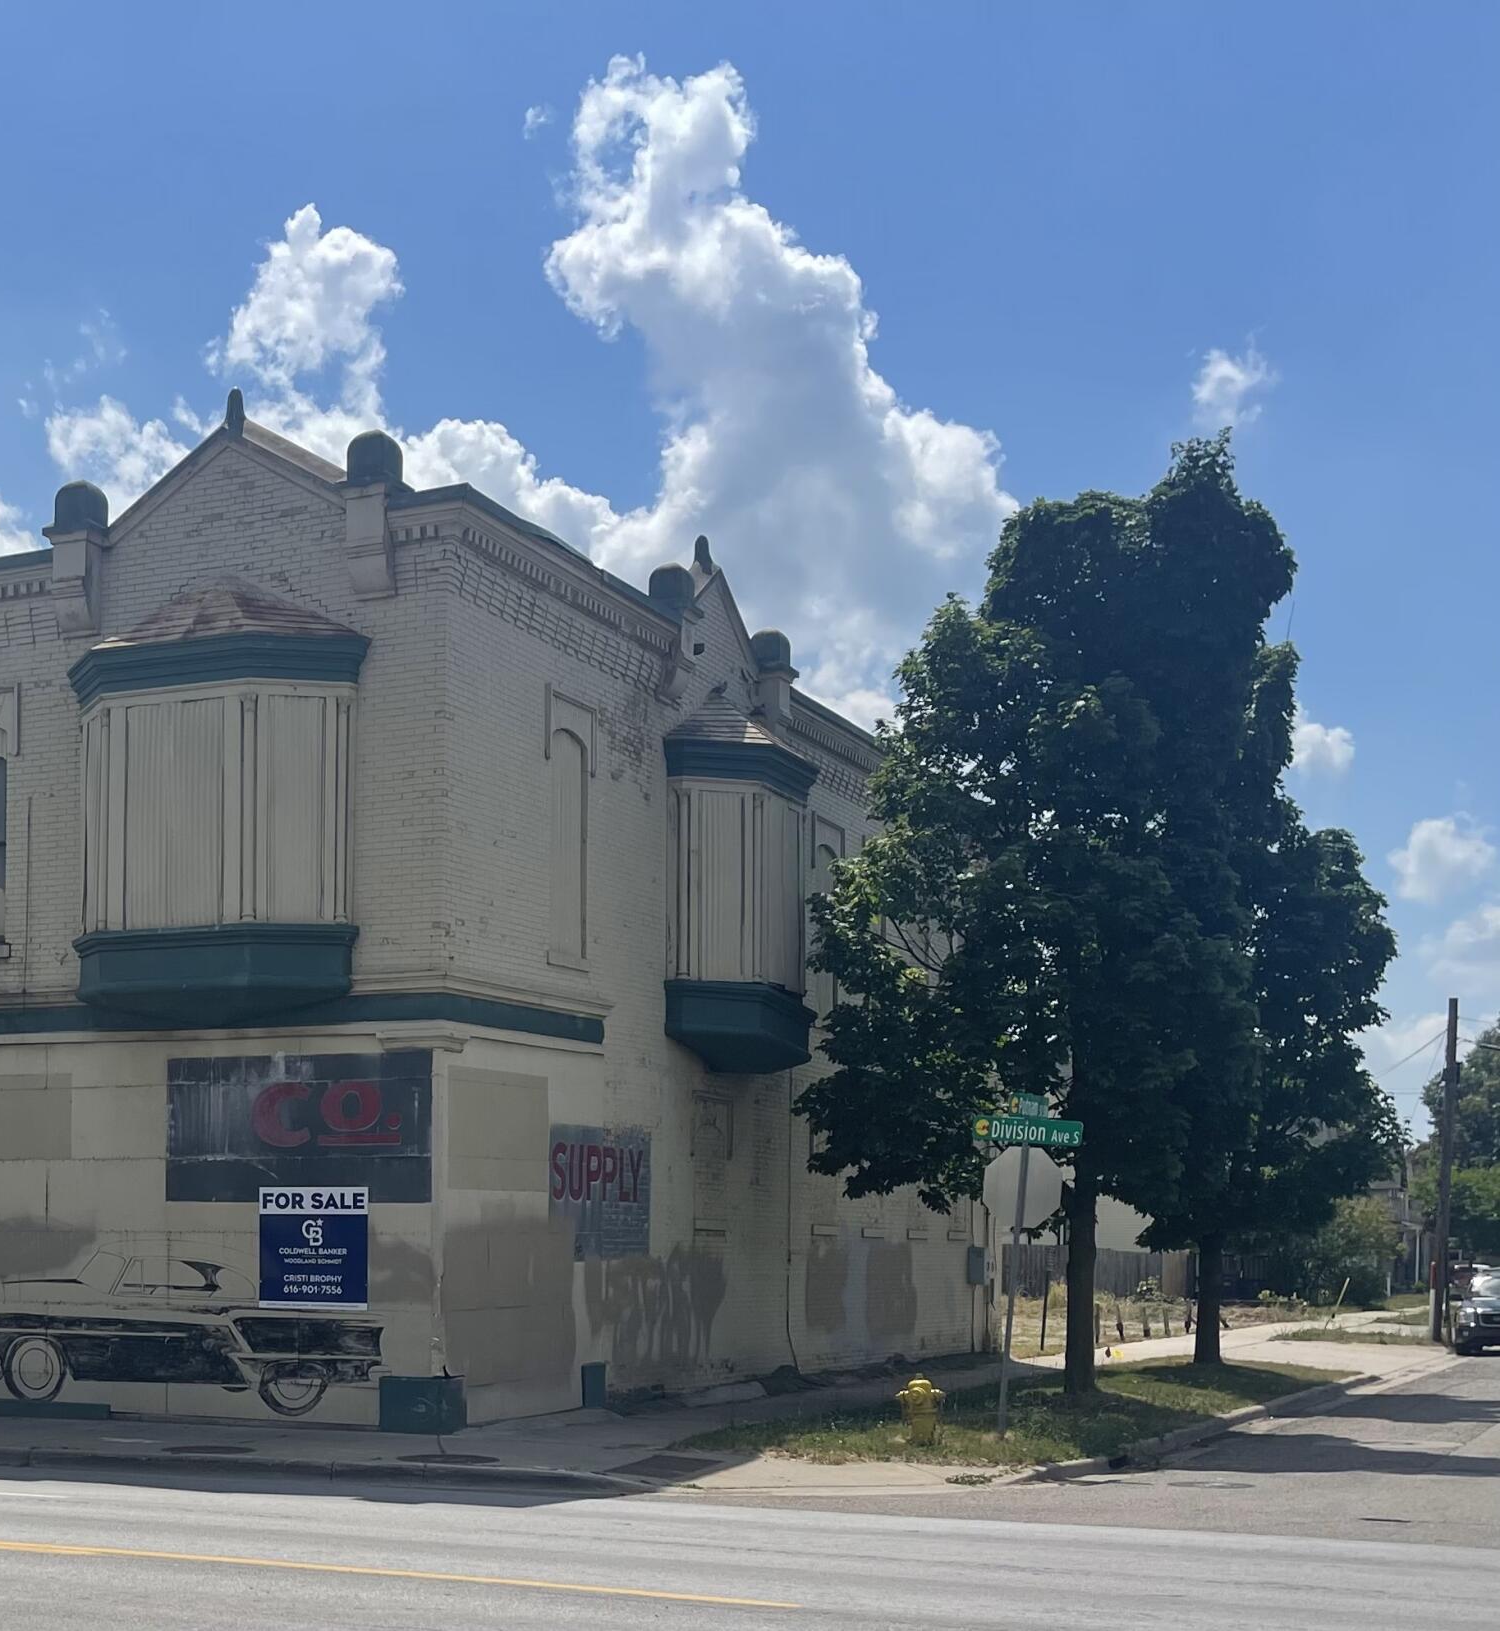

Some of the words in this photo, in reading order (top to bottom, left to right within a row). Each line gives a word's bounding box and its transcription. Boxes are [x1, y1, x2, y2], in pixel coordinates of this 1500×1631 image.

[992, 1120, 1046, 1142] Division
[1051, 1129, 1070, 1143] Ave
[1072, 1131, 1080, 1144] S
[552, 1142, 644, 1201] SUPPLY
[262, 1192, 305, 1210] FOR
[311, 1192, 365, 1210] SALE
[278, 1247, 317, 1255] COLDWELL
[318, 1247, 348, 1256] BANKER
[283, 1274, 309, 1282] CRISTI
[309, 1274, 343, 1283] BROPHY
